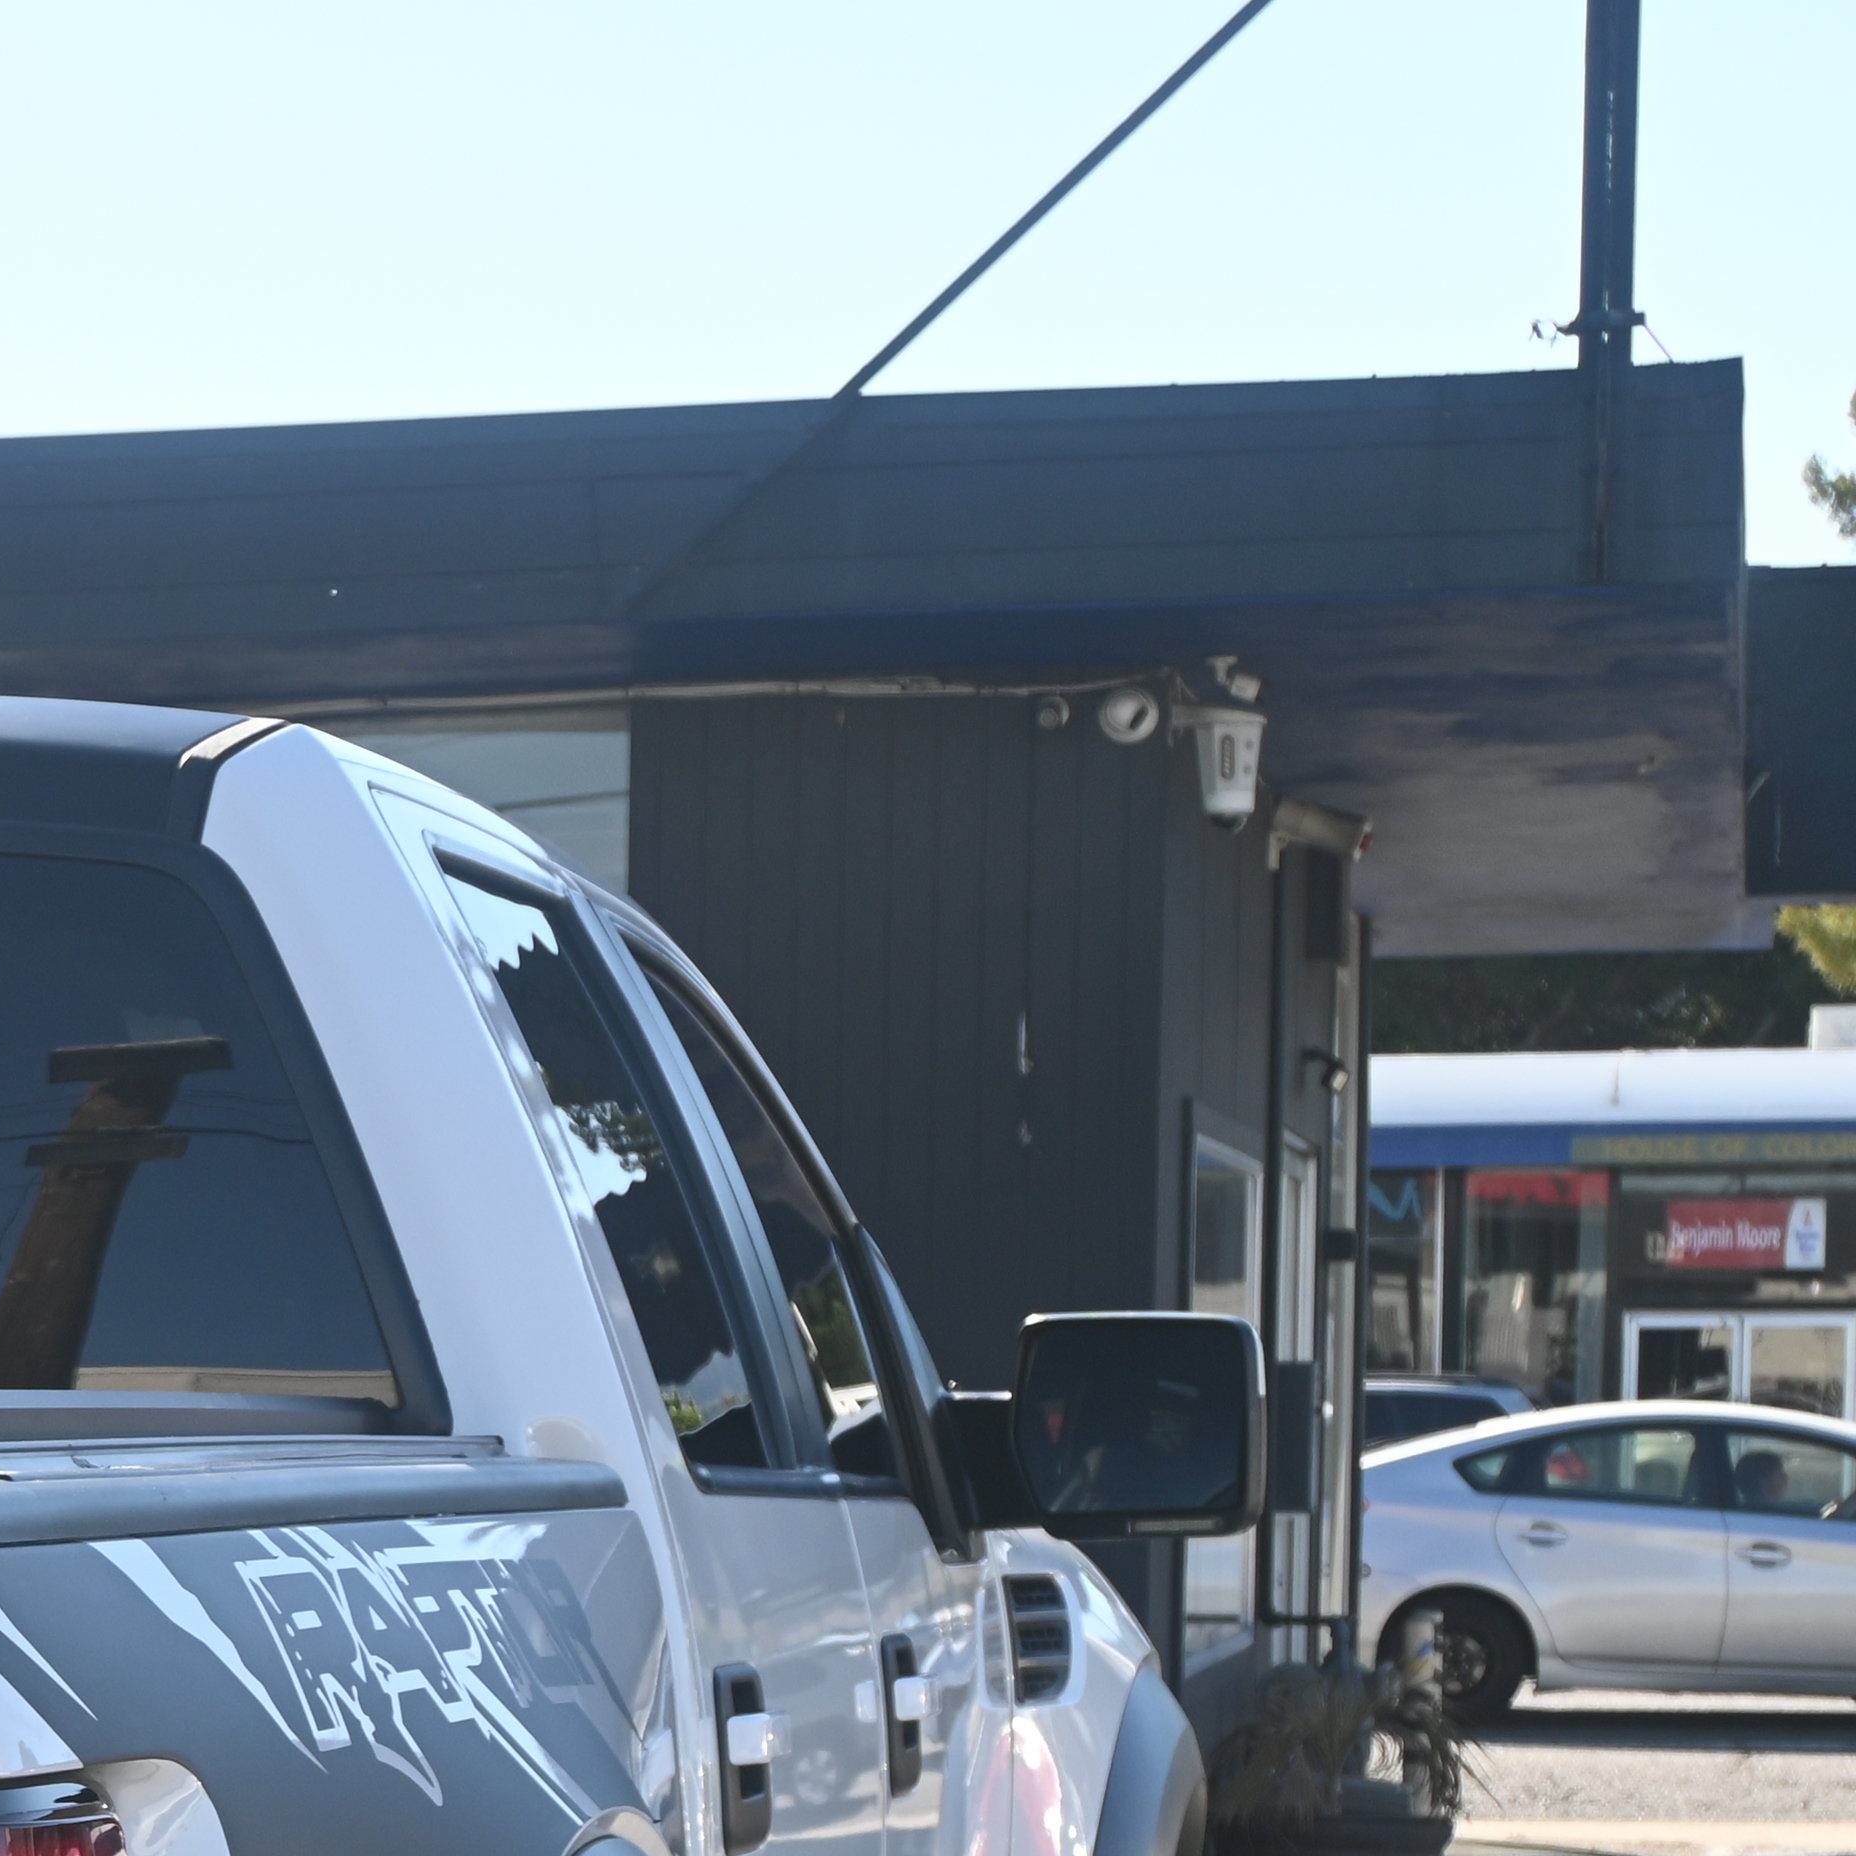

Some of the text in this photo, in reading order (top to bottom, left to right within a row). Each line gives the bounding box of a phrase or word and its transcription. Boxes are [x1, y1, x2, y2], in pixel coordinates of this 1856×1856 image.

[1605, 1136, 1700, 1161] HOUSE
[1710, 1136, 1745, 1160] OF
[1670, 1218, 1733, 1257] Benjamin
[1737, 1219, 1781, 1247] Moore
